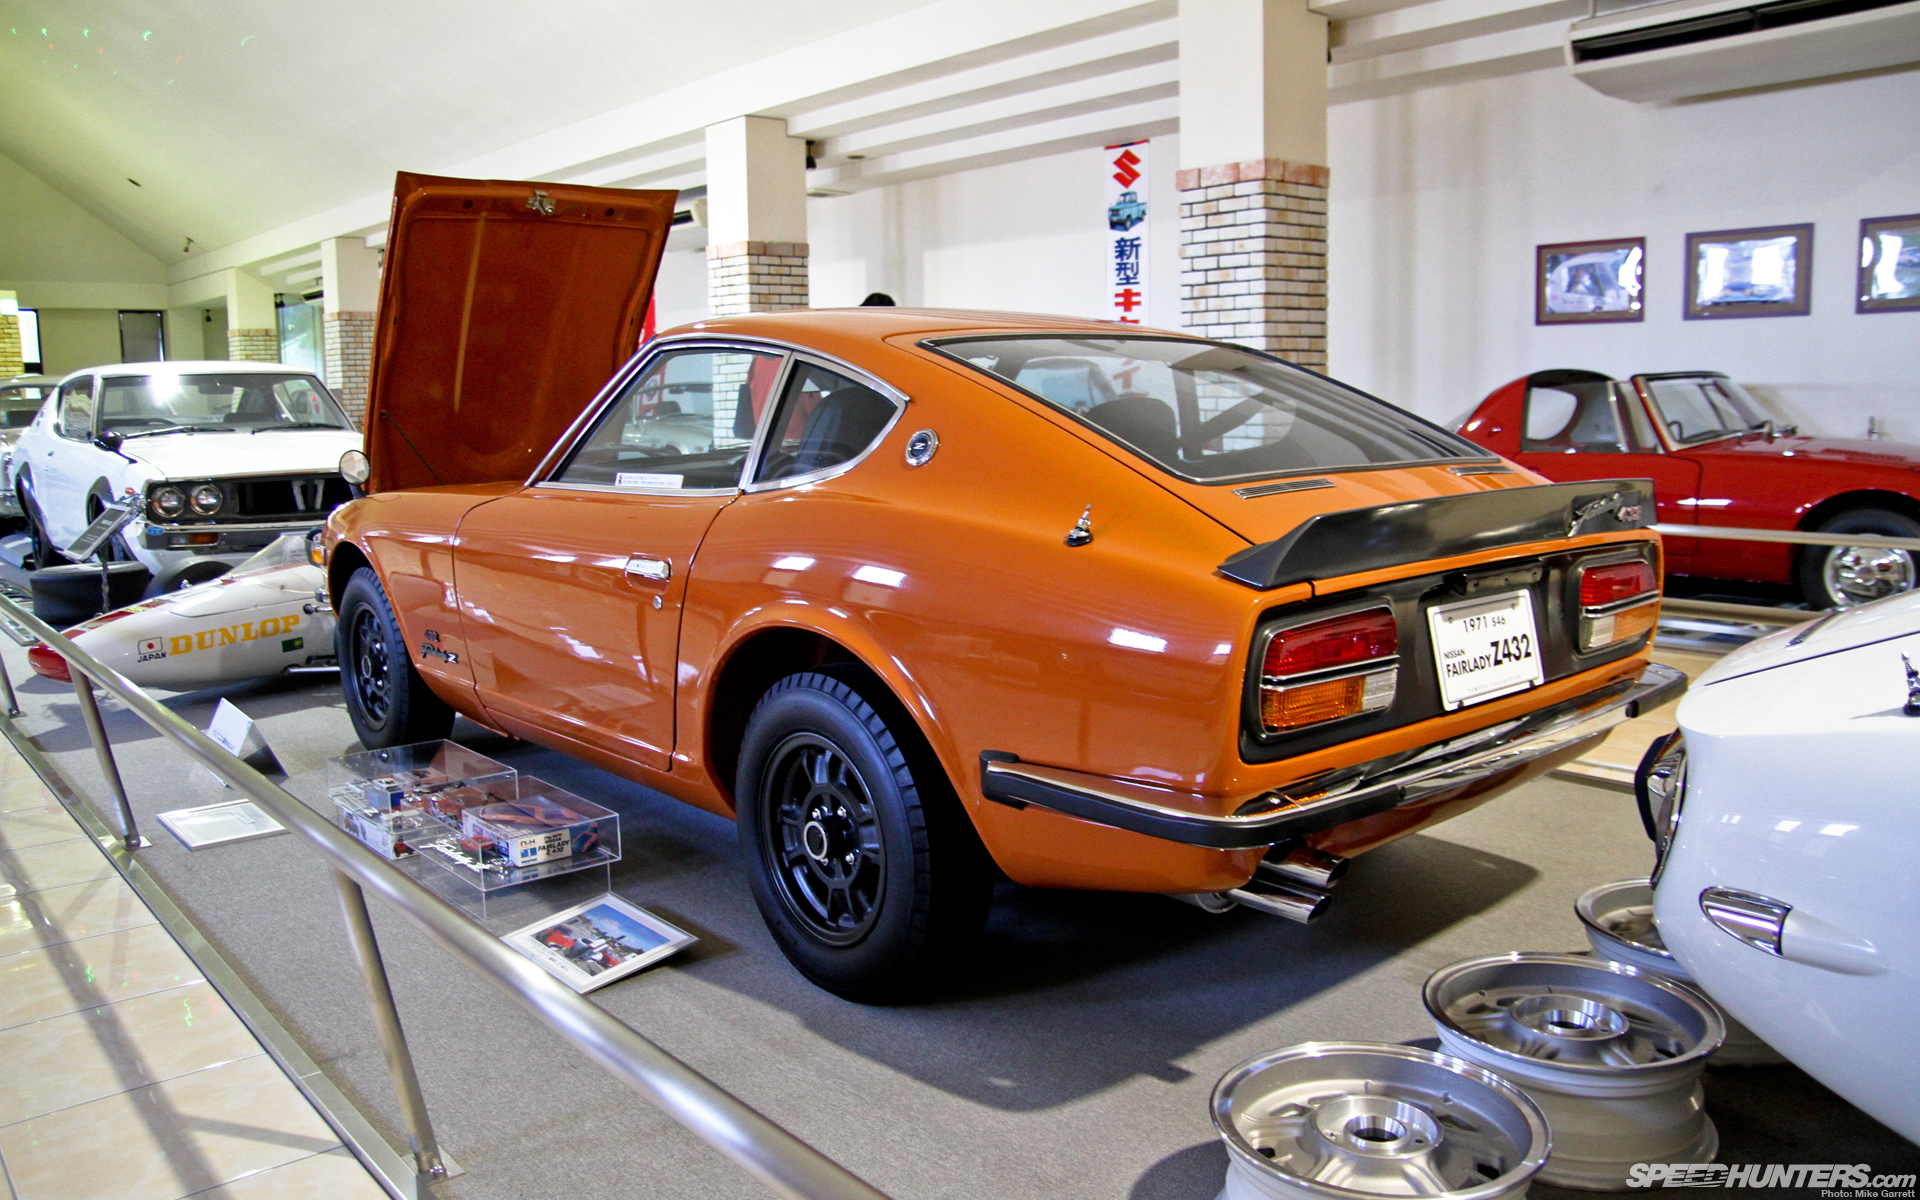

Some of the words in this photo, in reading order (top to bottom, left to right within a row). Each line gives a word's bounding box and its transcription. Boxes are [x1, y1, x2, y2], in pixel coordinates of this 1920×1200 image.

[1463, 616, 1488, 633] 1971
[1492, 615, 1506, 627] S46
[168, 614, 300, 656] DUNLOP
[137, 651, 167, 663] JAPAN
[1443, 648, 1466, 660] NISSAN
[1446, 654, 1492, 678] FAIRLADY
[1490, 633, 1533, 667] Z432
[538, 840, 570, 852] FAIRLADY
